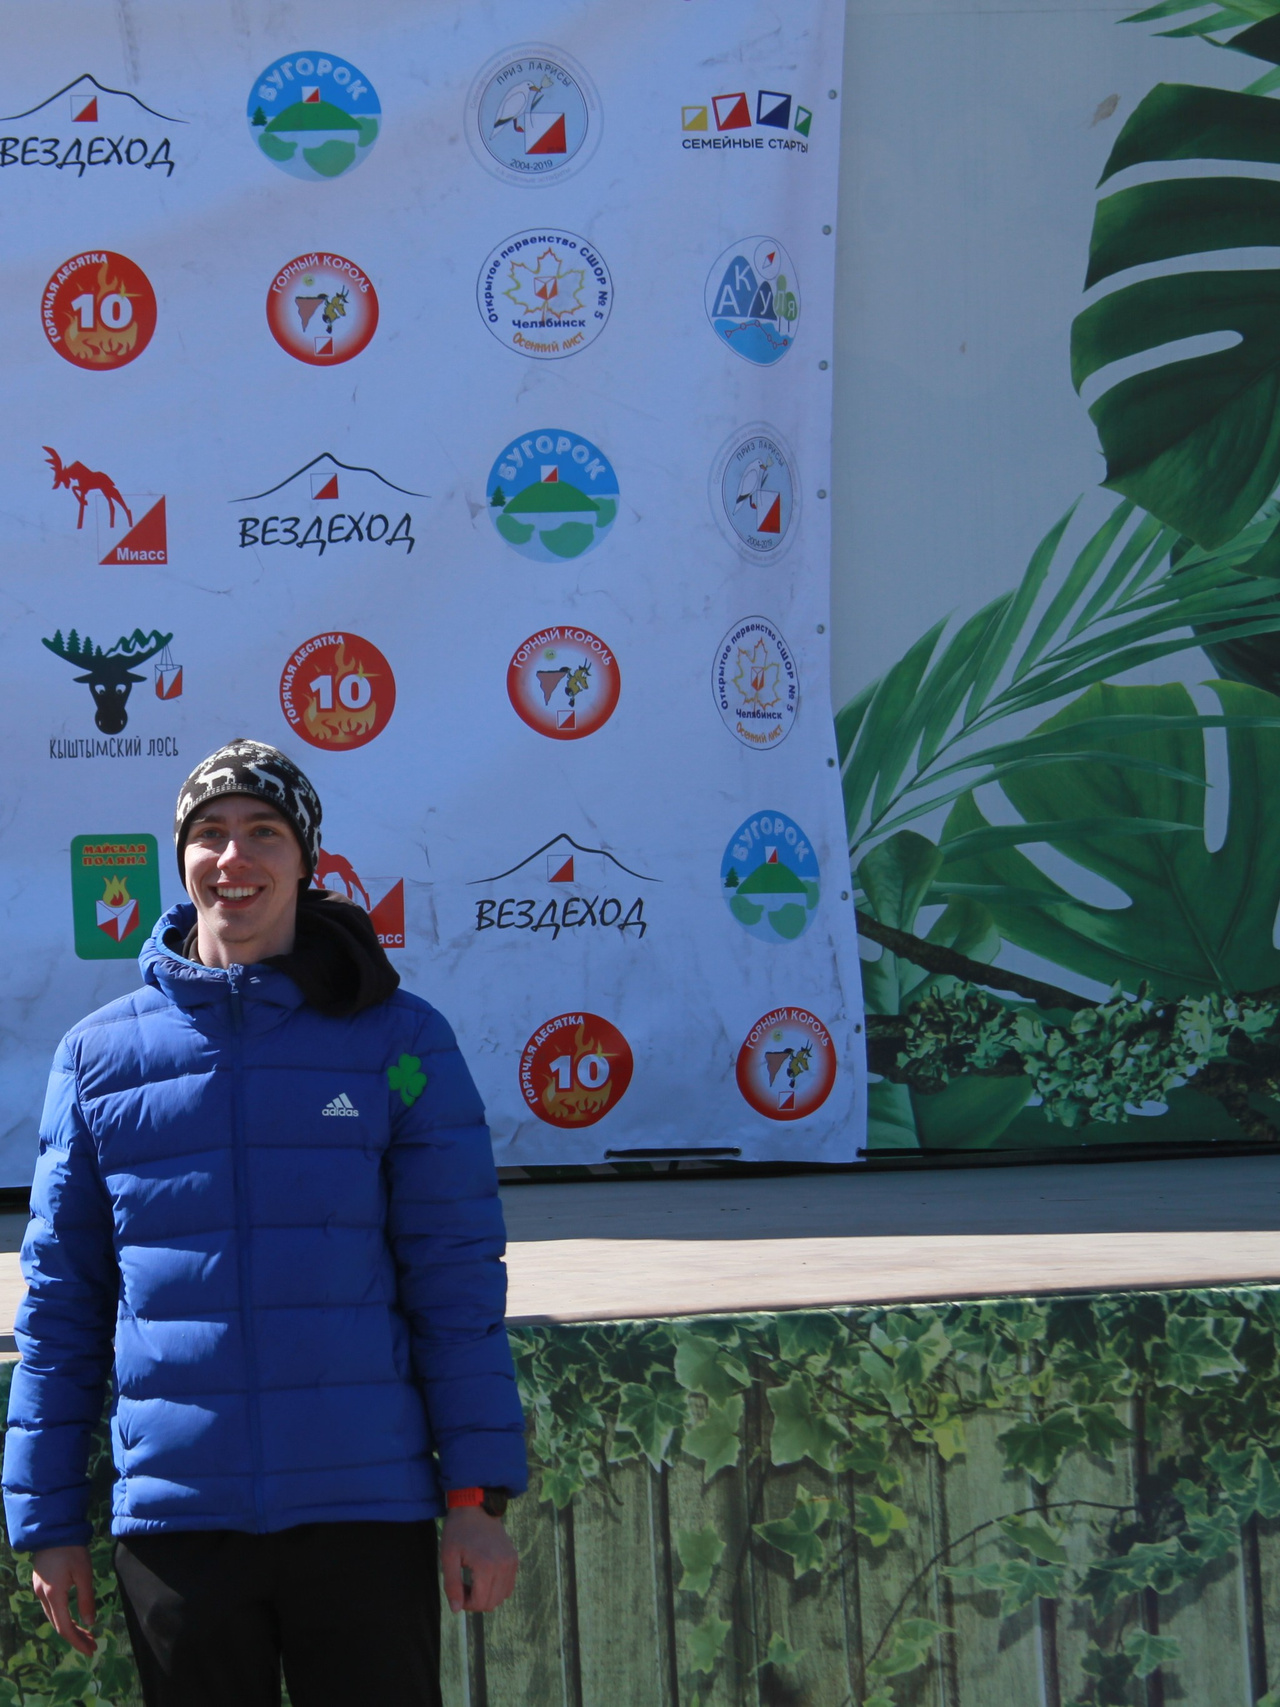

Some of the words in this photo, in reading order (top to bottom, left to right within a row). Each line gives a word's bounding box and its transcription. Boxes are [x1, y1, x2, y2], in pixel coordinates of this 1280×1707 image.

[259, 57, 368, 101] БУГОРОК
[496, 65, 524, 87] ПРИЗ
[528, 62, 572, 88] ЛАРИСЫ
[682, 136, 764, 149] СЕМЕЙНЫЕ
[768, 138, 809, 153] СТАРТЫ
[510, 158, 553, 171] 2004-2019
[272, 253, 320, 293] ГОРНЫЙ
[323, 255, 370, 293] КОРОЛЬ
[485, 259, 501, 323] Открытое
[500, 235, 577, 260] первенство
[579, 247, 607, 285] СШОР
[594, 311, 604, 320] 5
[43, 284, 61, 343] ГОРЯЧАЯ
[57, 253, 108, 285] ДЕСЯТКА
[70, 293, 133, 329] 10
[512, 318, 586, 329] Челябинск
[498, 435, 607, 482] БУГОРОК
[736, 441, 756, 462] ПРИЗ
[758, 440, 784, 468] ЛАРИСЫ
[238, 512, 415, 556] ВЕЗДЕХОД
[117, 547, 166, 562] Миасс
[513, 627, 560, 669] ГОРНЫЙ
[564, 629, 612, 666] КОРОЛЬ
[282, 666, 300, 725] ГОРЯЧАЯ
[294, 635, 345, 666] ДЕСЯТКА
[718, 645, 732, 710] Открытое
[731, 623, 775, 644] первенство
[776, 640, 794, 679] СШОР
[786, 704, 793, 713] 5
[309, 674, 371, 709] 10
[736, 709, 782, 719] Челябинск
[49, 735, 142, 759] КЫШТЫМСКИЙ
[83, 844, 147, 854] МАЙСКАЯ
[732, 816, 810, 862] БУГОРОК
[83, 856, 147, 866] ПОЛЯНА
[475, 895, 647, 940] ВЕЗДЕХОД
[376, 933, 403, 945] асс
[746, 1007, 788, 1050] ГОРНЫЙ
[790, 1009, 829, 1047] КОРОЛЬ
[522, 1046, 538, 1103] ГОРЯЧАЯ
[533, 1015, 584, 1047] ДЕСЯТКА
[549, 1054, 610, 1089] 10
[322, 1107, 359, 1117] adidas
